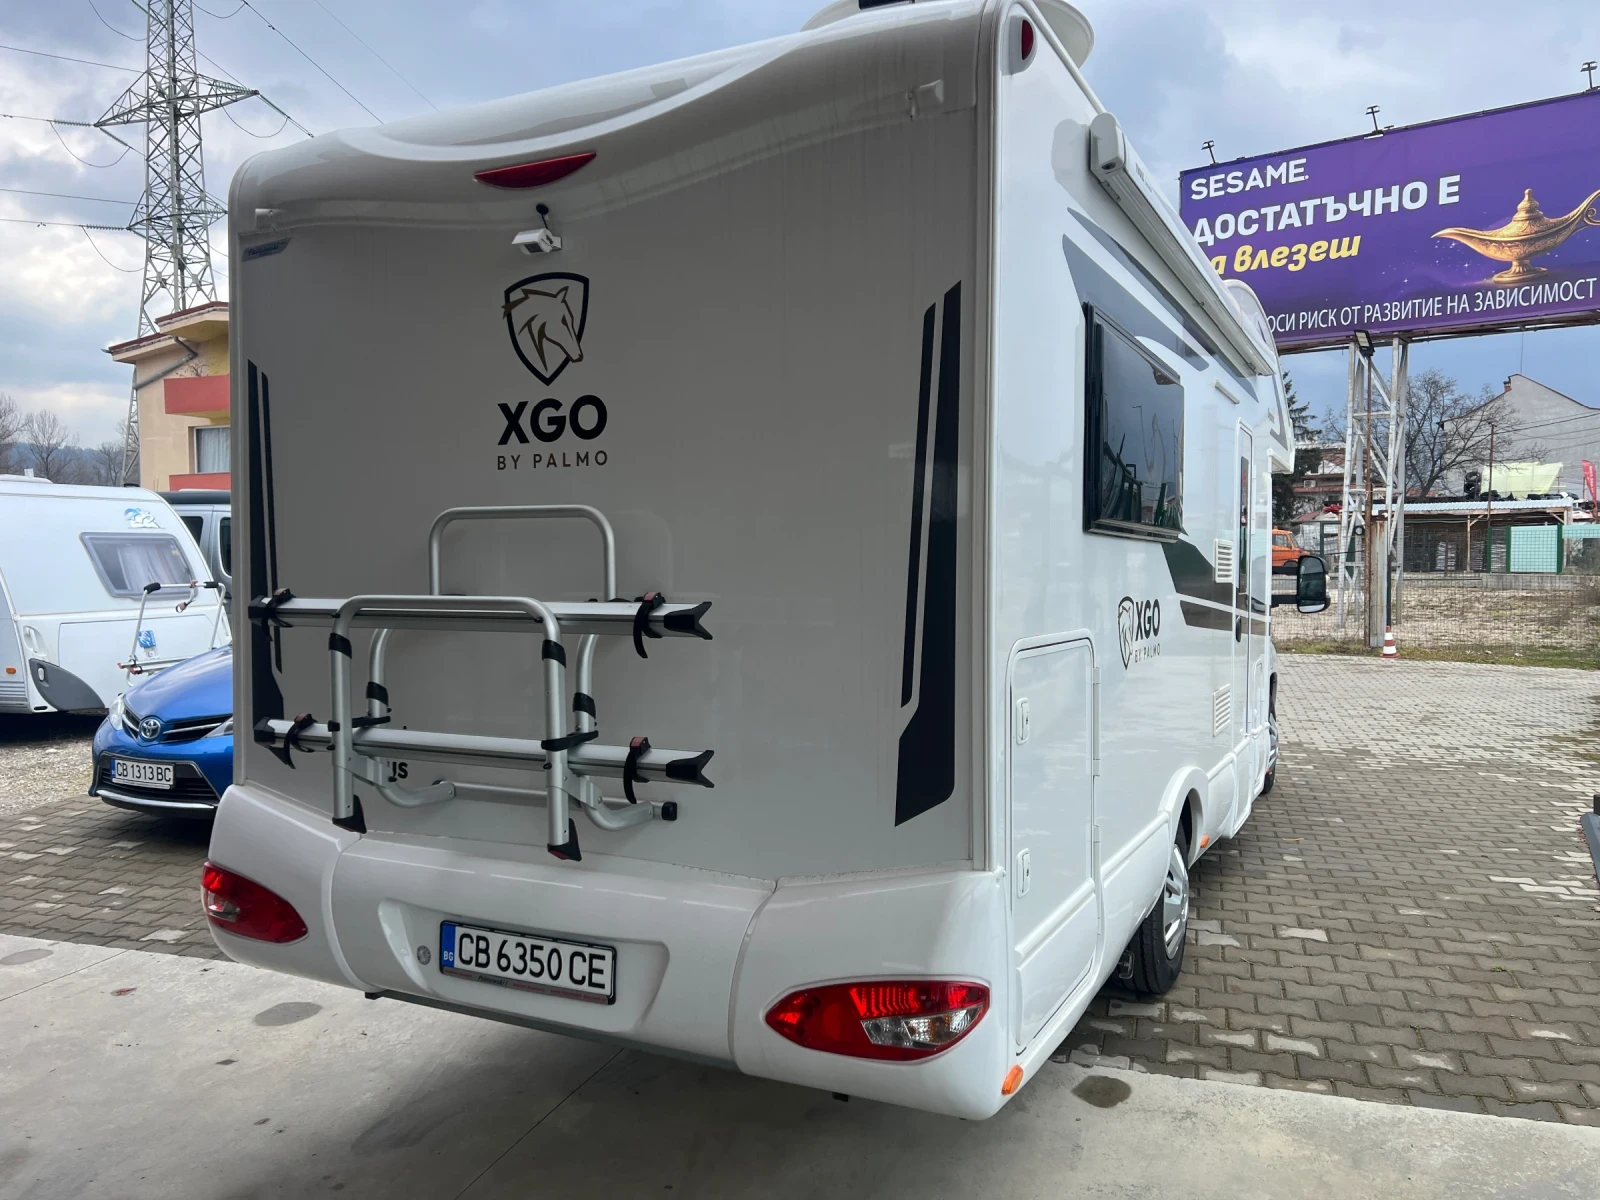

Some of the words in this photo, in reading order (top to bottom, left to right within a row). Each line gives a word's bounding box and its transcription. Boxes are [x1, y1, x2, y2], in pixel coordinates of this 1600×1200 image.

[1193, 181, 1428, 246] ДОСТАТЪЧНО
[1438, 175, 1461, 205] Е
[1233, 235, 1361, 273] влезеш
[1299, 308, 1337, 330] РИСК
[1340, 305, 1361, 326] ОТ
[1364, 297, 1443, 324] РАЗВИТИЕ
[1447, 293, 1470, 315] НА
[1474, 277, 1598, 312] ЗАВИСИМОСТ
[497, 394, 608, 446] XGO
[497, 454, 521, 470] BY
[533, 450, 608, 469] PALMO
[1135, 598, 1161, 642] XGO
[130, 764, 155, 781] 1313
[156, 766, 172, 783] BC
[443, 950, 454, 962] BG
[458, 932, 491, 969] CB
[496, 940, 563, 982] 6350
[568, 950, 606, 990] CE
